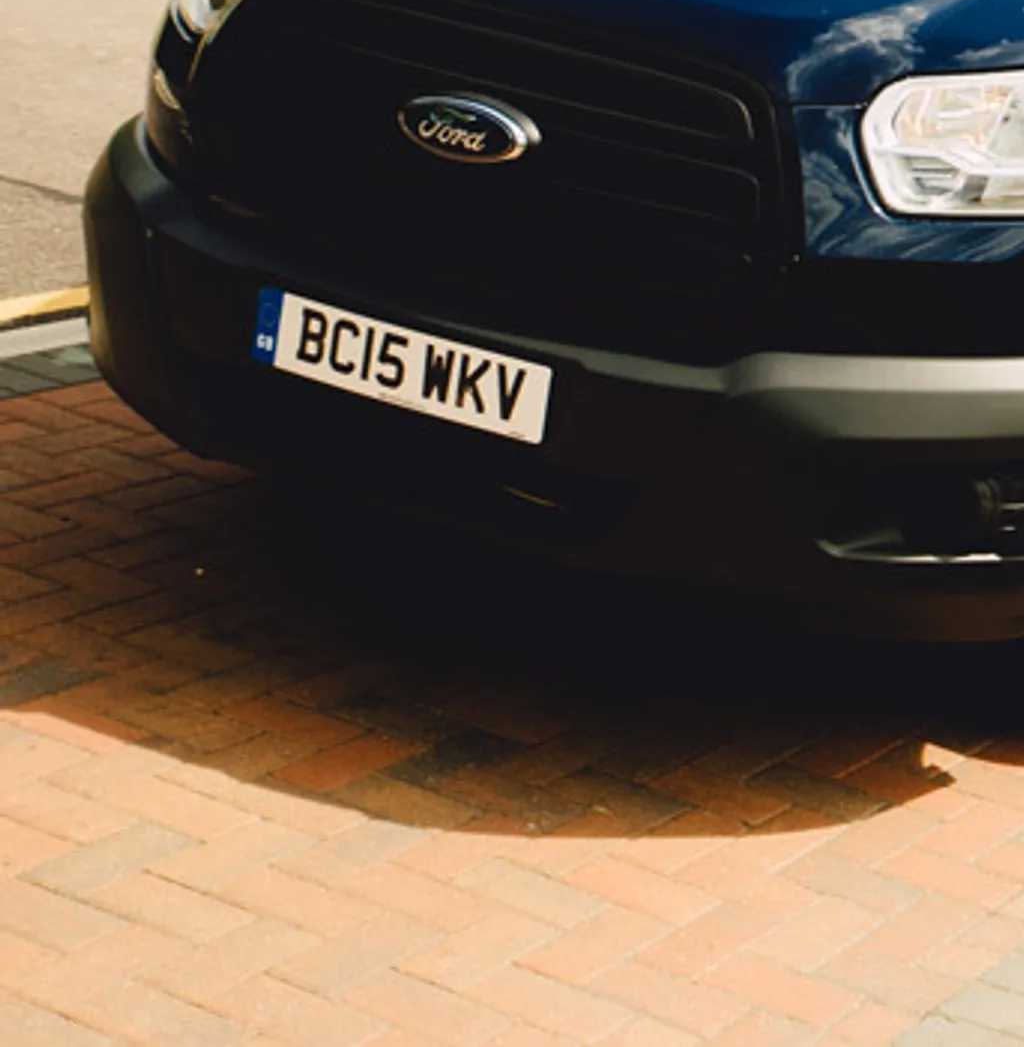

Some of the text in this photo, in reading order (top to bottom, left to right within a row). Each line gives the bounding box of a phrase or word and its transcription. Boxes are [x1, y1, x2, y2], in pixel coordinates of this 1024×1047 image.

[418, 109, 487, 152] Ford
[296, 307, 527, 422] BC15 WKV
